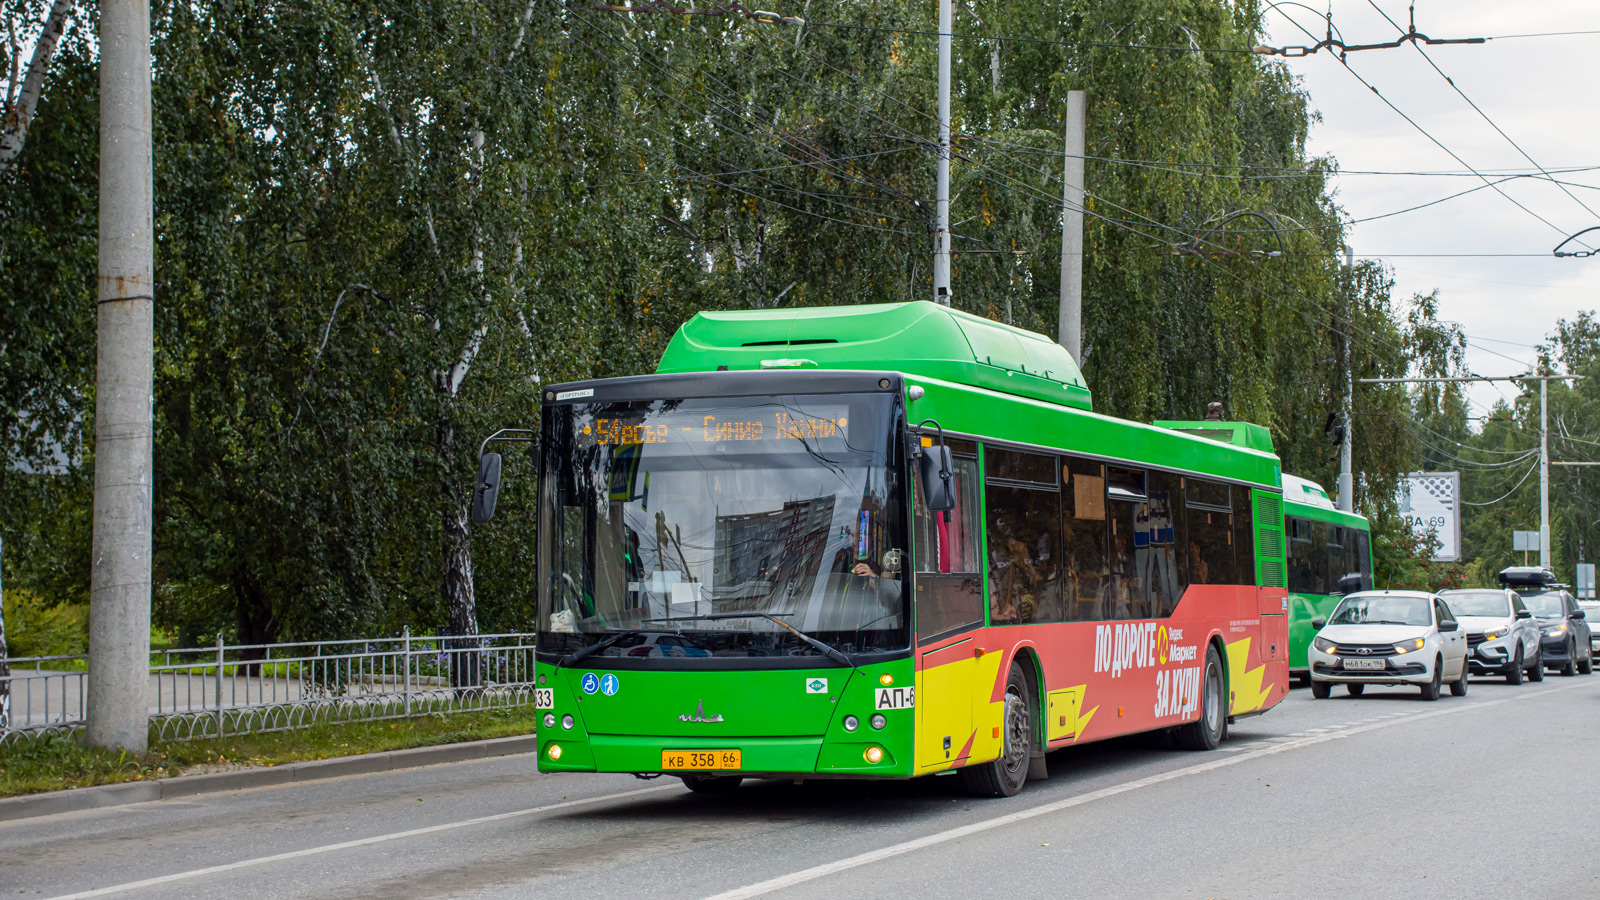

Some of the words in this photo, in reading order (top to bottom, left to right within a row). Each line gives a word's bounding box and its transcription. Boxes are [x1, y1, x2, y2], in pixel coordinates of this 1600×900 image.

[703, 415, 763, 441] Синие
[775, 412, 836, 439] Камни
[1430, 516, 1445, 527] 69
[1169, 627, 1184, 642] Яндекс
[1094, 624, 1112, 673] ПО
[1112, 622, 1157, 678] ДОРОГЕ
[1169, 644, 1198, 664] Маркет
[536, 690, 552, 707] 33
[1154, 670, 1170, 718] ЗА
[1169, 667, 1200, 720] ХУДИ
[690, 753, 715, 767] 358
[722, 752, 736, 763] 66
